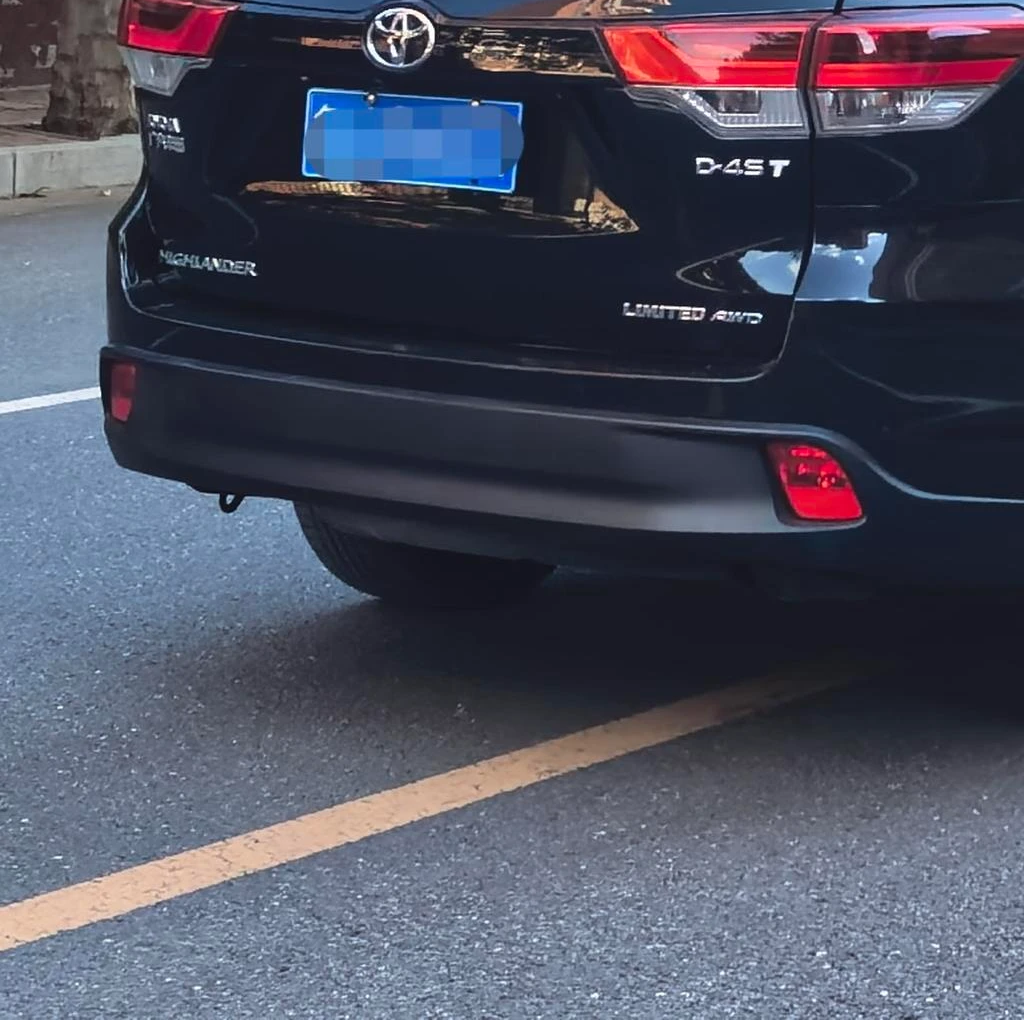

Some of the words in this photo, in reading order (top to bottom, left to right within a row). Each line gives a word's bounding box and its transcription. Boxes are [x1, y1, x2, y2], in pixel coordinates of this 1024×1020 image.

[160, 249, 257, 276] HIGHLANDER
[623, 302, 706, 320] LIMITED
[710, 310, 763, 324] AWD
